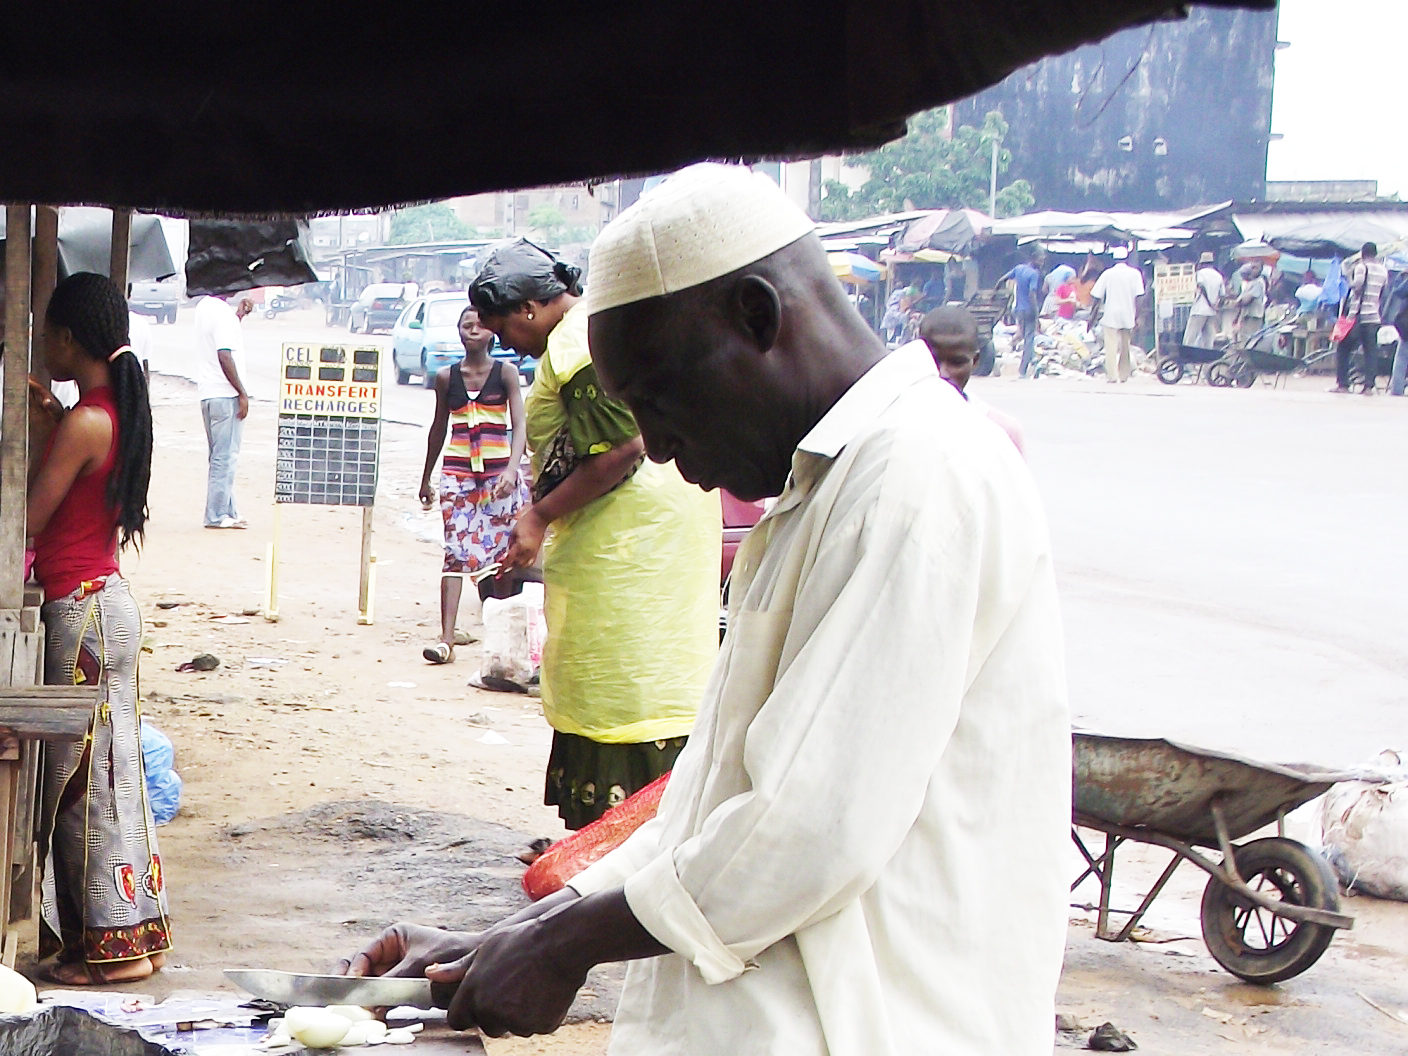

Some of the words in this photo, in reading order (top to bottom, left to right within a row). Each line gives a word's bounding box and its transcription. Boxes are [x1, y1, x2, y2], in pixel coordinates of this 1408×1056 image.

[286, 347, 314, 363] CEL
[285, 383, 379, 399] TRANSFERT
[283, 398, 378, 414] RECHARGES
